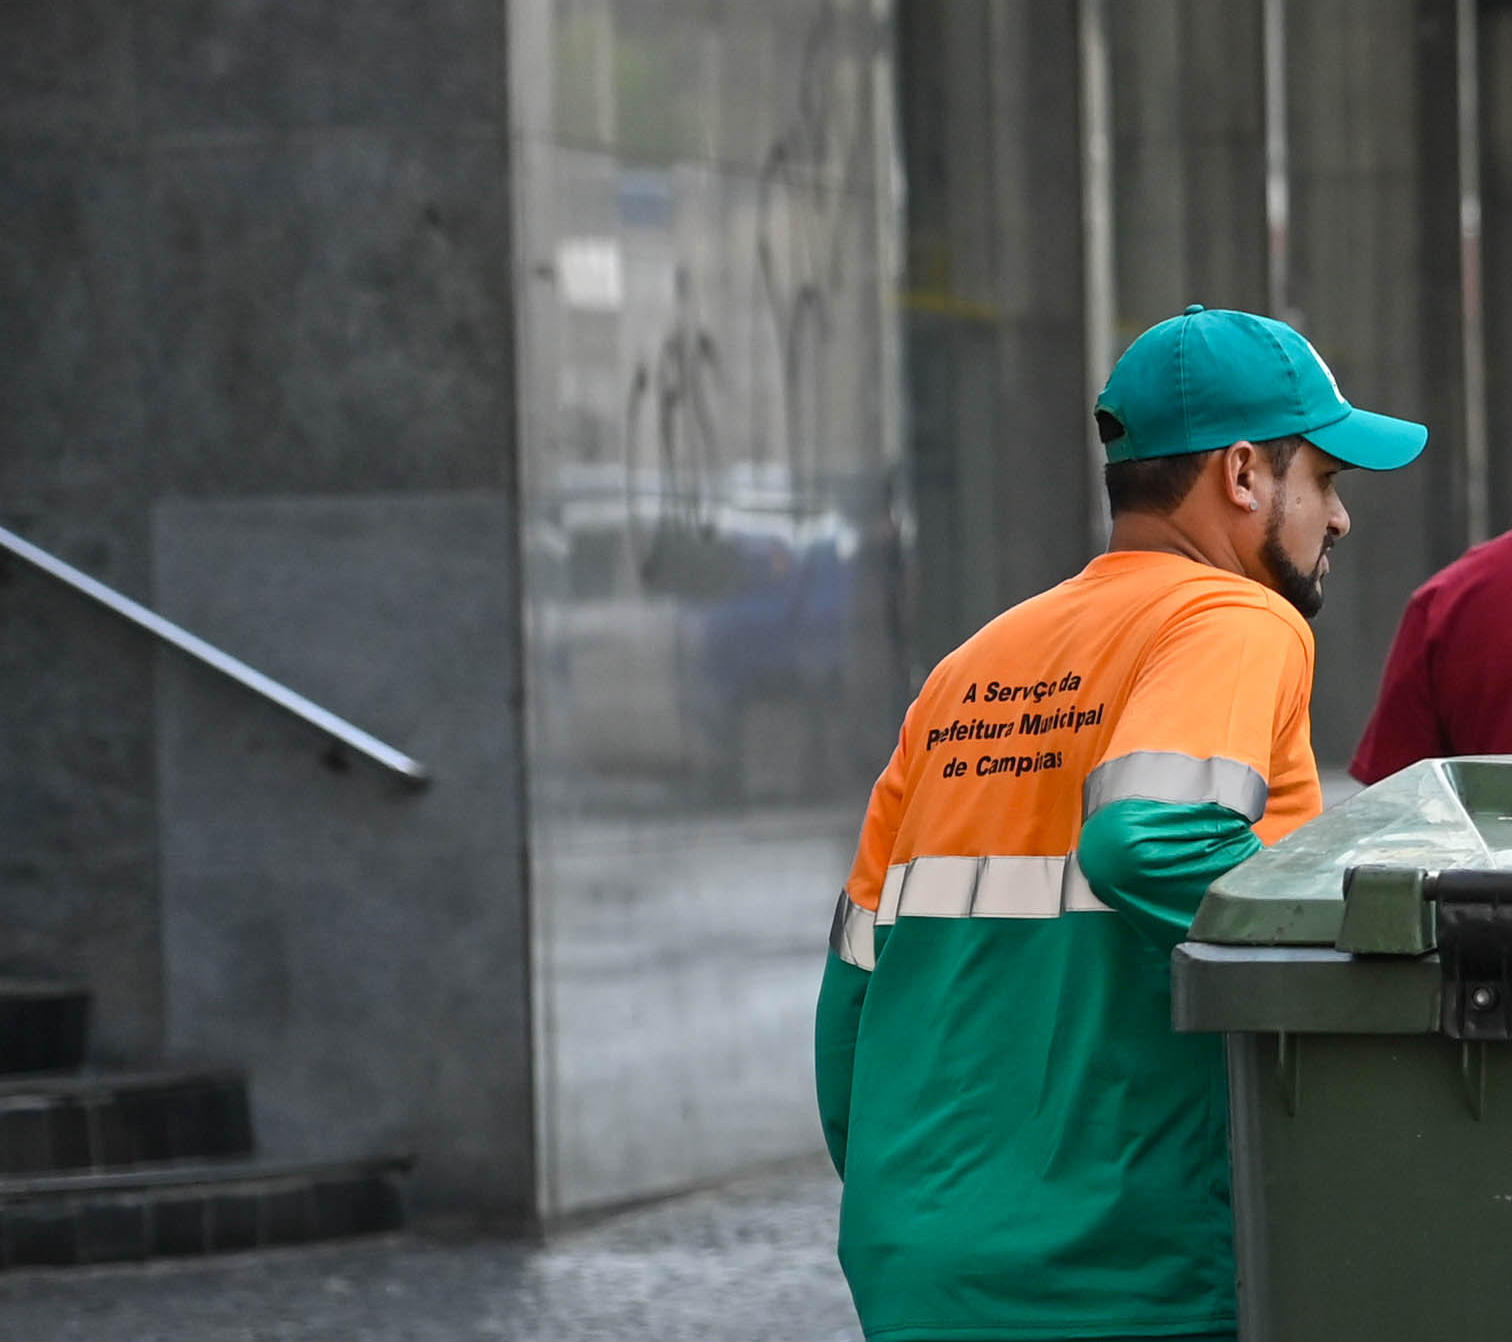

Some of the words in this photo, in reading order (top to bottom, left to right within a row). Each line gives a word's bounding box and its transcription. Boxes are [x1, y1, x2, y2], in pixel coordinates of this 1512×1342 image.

[962, 682, 977, 704] A
[983, 681, 1057, 704] Servço
[1058, 671, 1082, 692] da
[926, 719, 1015, 751] Pefeitura
[943, 757, 968, 779] de
[976, 751, 1064, 777] Campias
